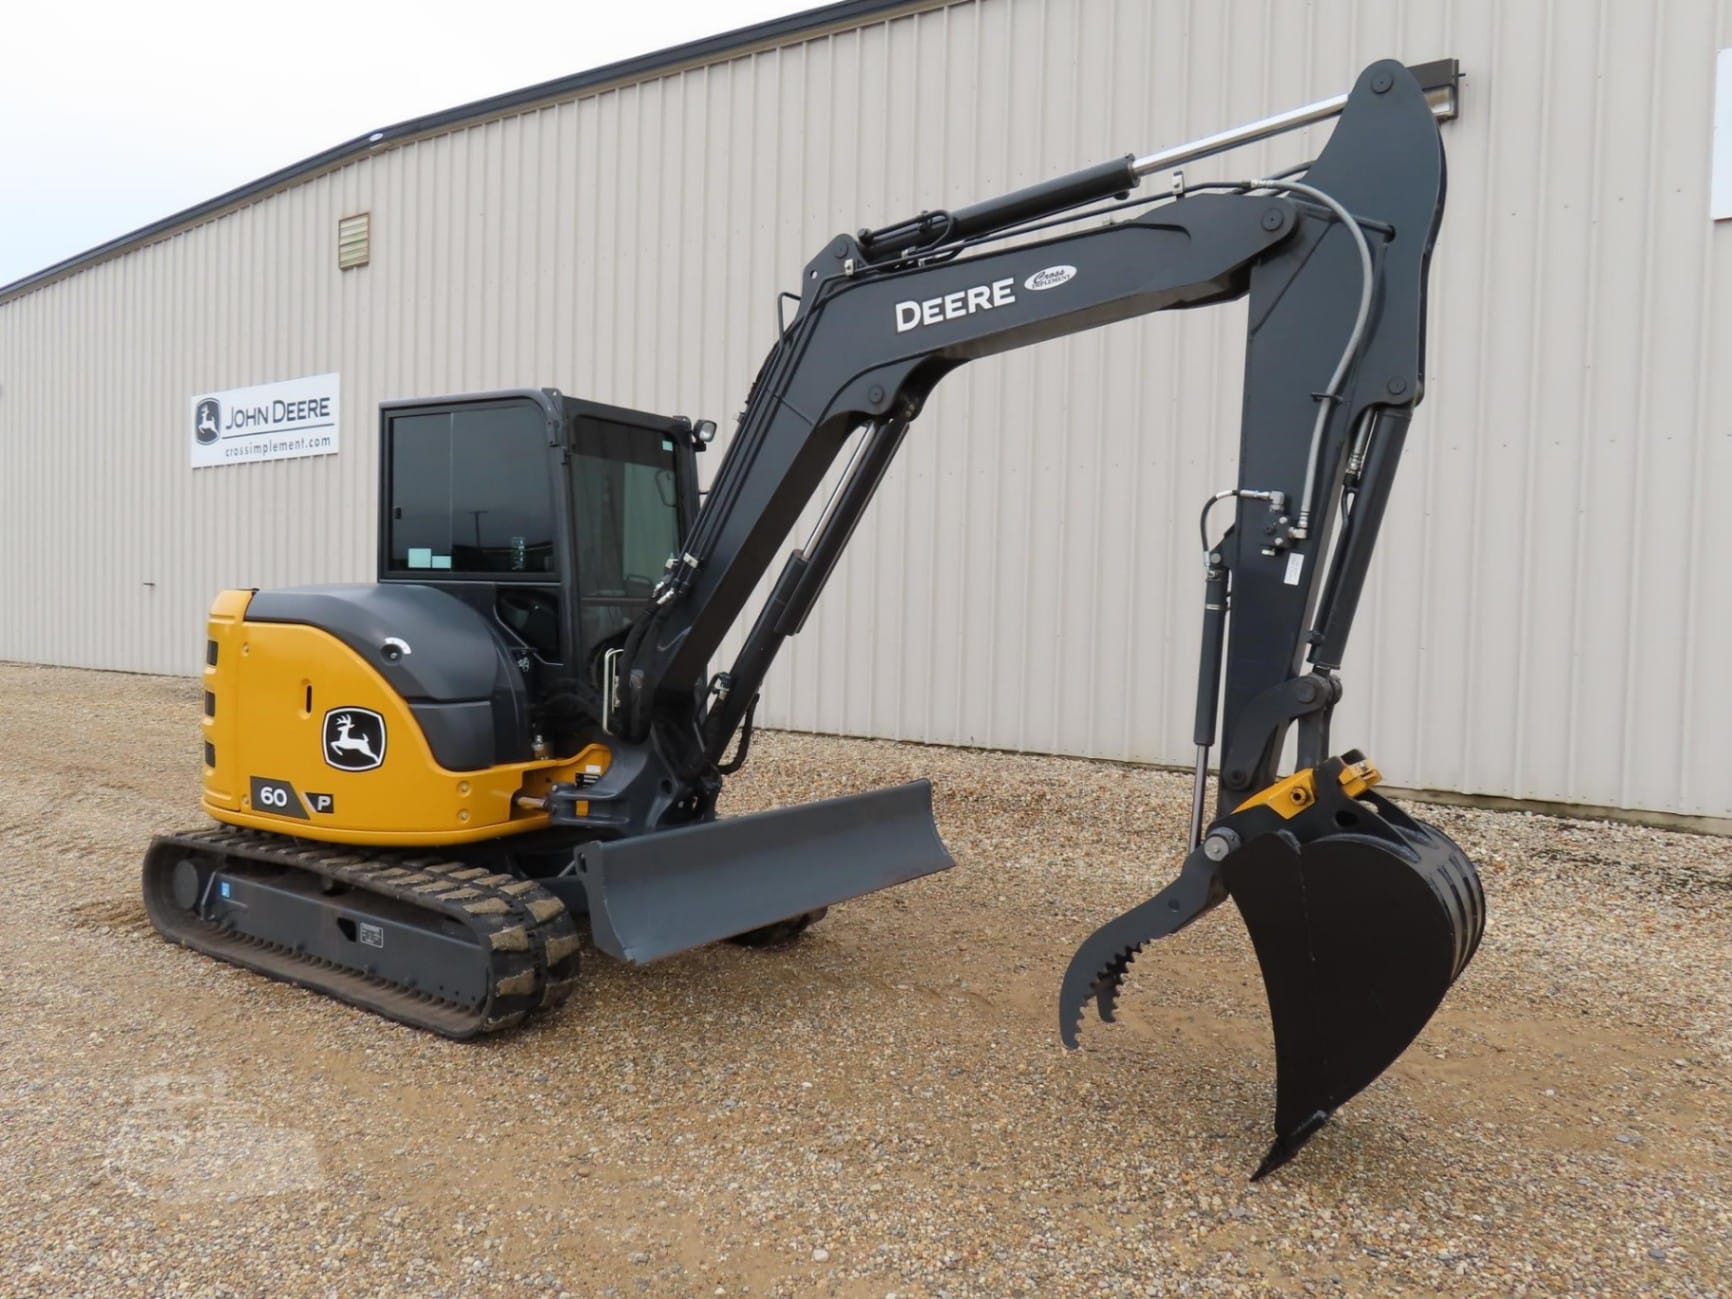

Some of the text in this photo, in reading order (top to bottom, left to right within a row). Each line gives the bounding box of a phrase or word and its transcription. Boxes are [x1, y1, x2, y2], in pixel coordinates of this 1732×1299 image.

[895, 277, 1016, 333] DEERE
[225, 397, 331, 430] JOHN DEERE
[225, 436, 331, 457] crossimplement.com
[260, 786, 331, 811] 60 P
